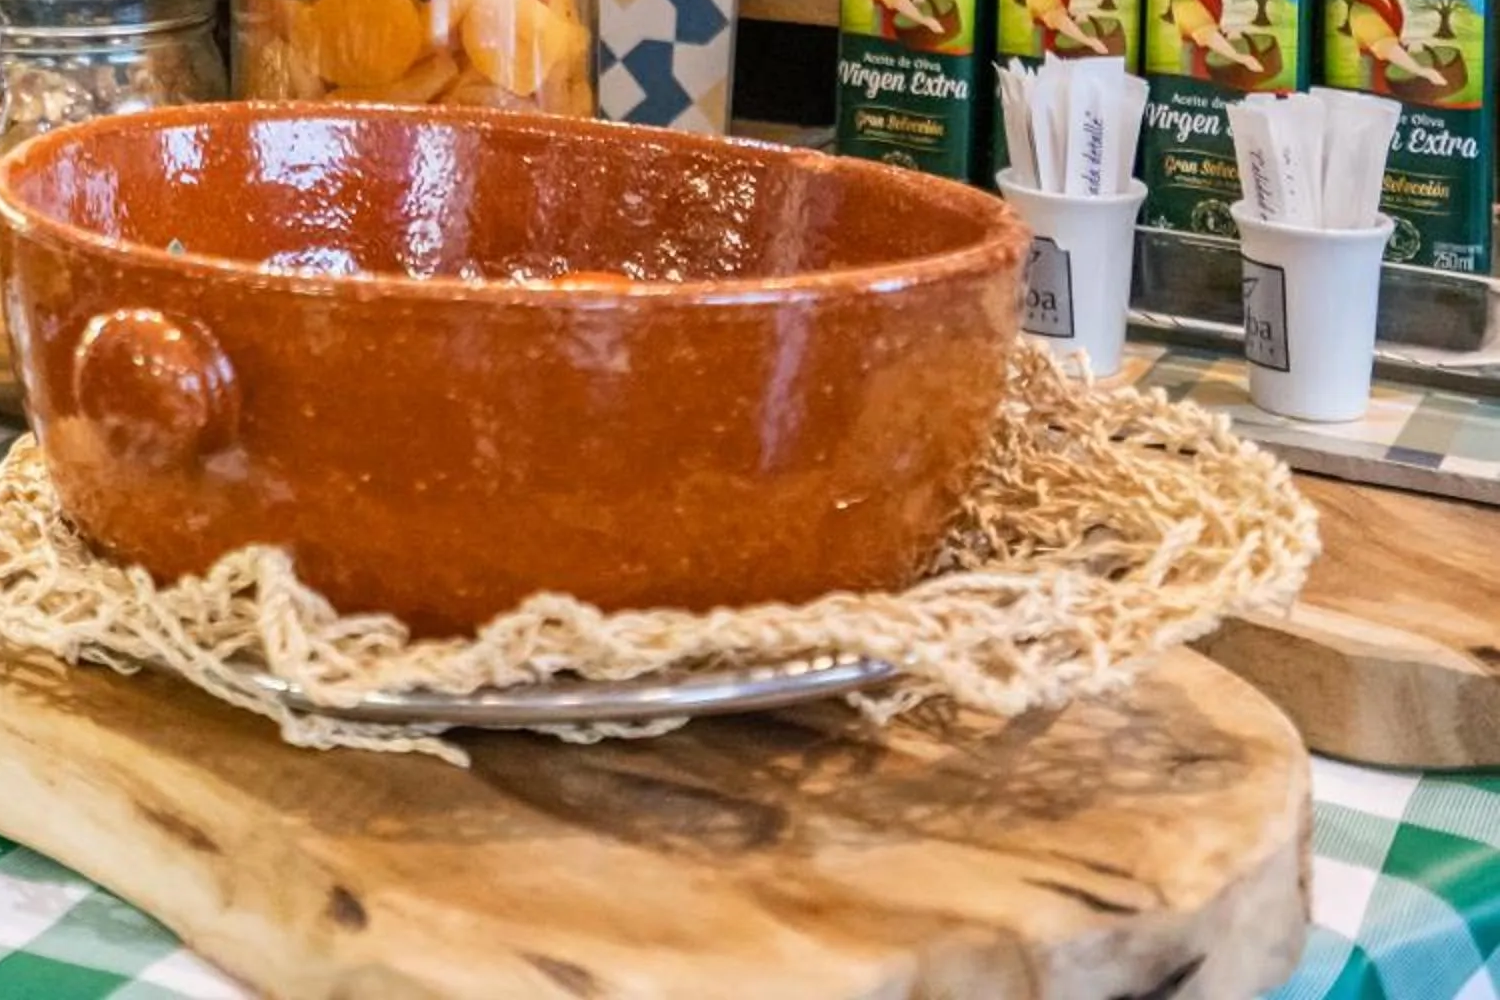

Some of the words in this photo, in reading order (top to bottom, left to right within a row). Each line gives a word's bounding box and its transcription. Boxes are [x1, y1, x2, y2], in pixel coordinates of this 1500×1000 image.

[838, 60, 905, 99] Virgen
[910, 71, 969, 100] Extra
[1146, 103, 1222, 143] Virgen
[1407, 126, 1479, 160] Extra
